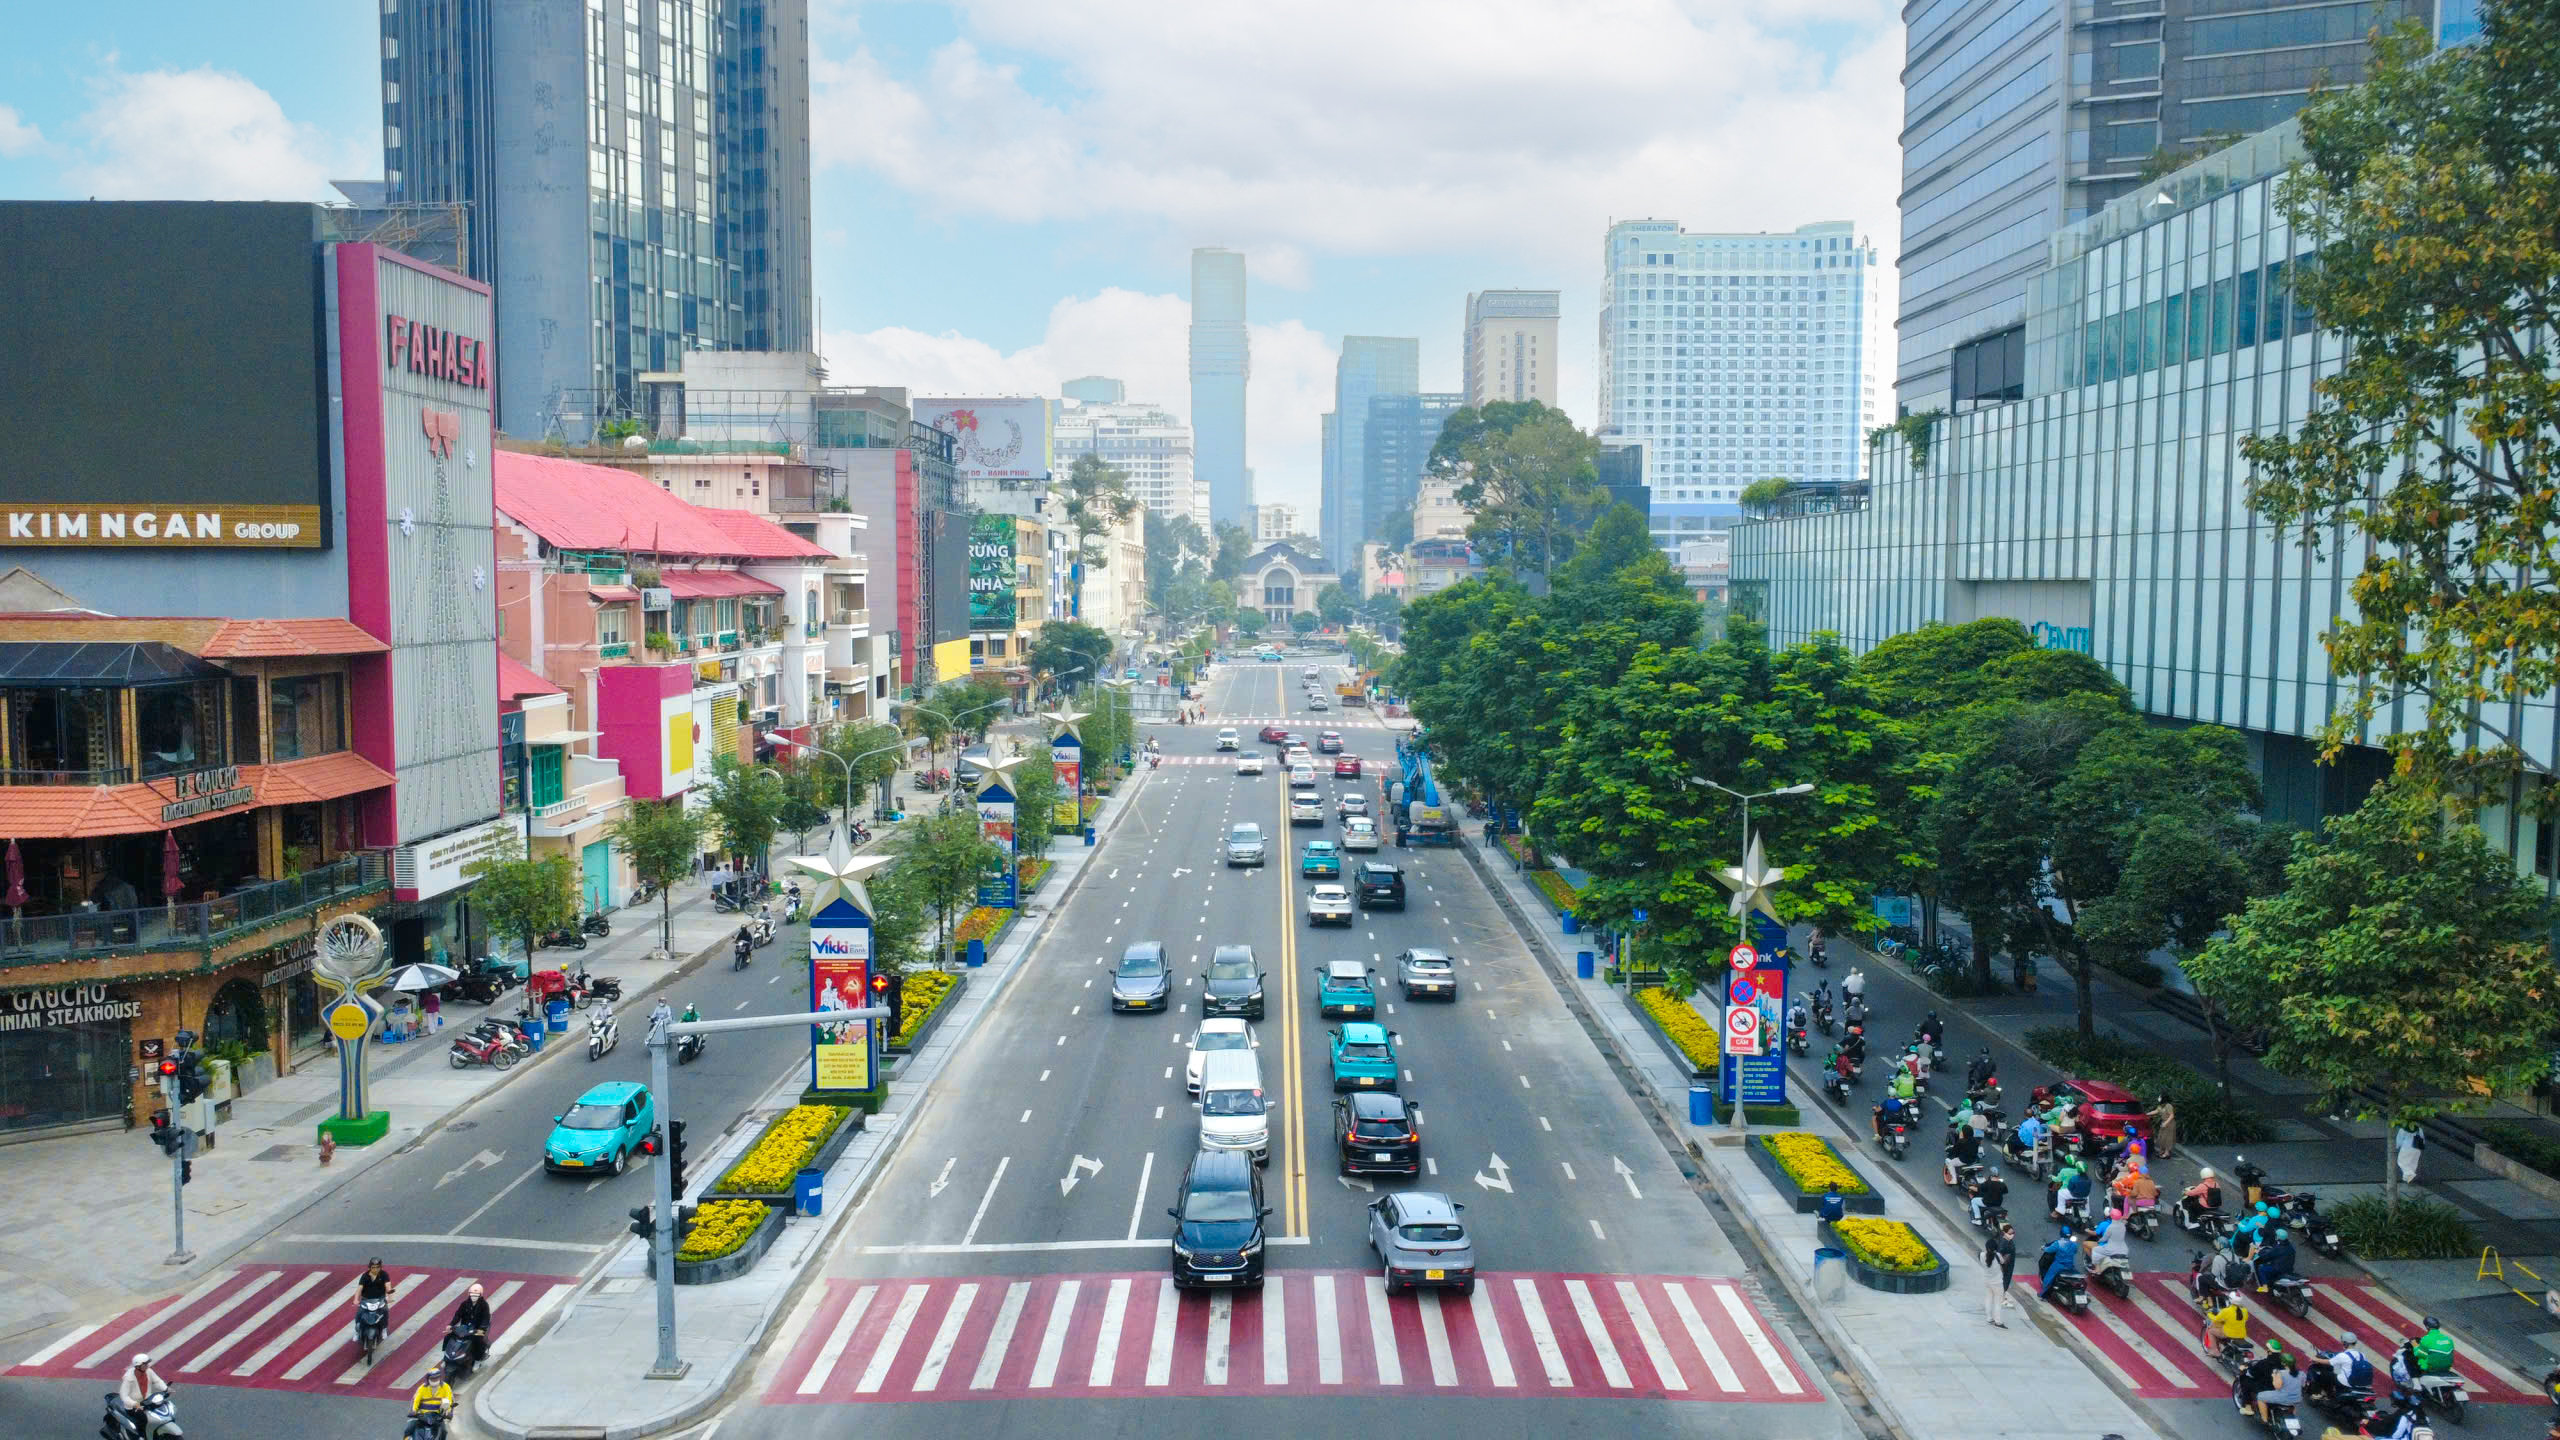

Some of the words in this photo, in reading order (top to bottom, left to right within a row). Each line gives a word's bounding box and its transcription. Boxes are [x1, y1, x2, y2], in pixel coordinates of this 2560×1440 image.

[387, 314, 489, 389] FAHASA
[9, 513, 88, 539] KIM
[101, 512, 222, 539] NGAN
[234, 523, 300, 539] GROUP
[970, 575, 1004, 591] NHÀ
[176, 775, 194, 798] EL
[194, 764, 240, 794] GAUCHO
[211, 785, 256, 810] STEAKHOUSE
[978, 806, 1002, 820] Vikki
[811, 934, 849, 955] Vikki
[13, 984, 106, 1012] GAUCHO
[47, 1001, 142, 1026] STEAKHOUSE
